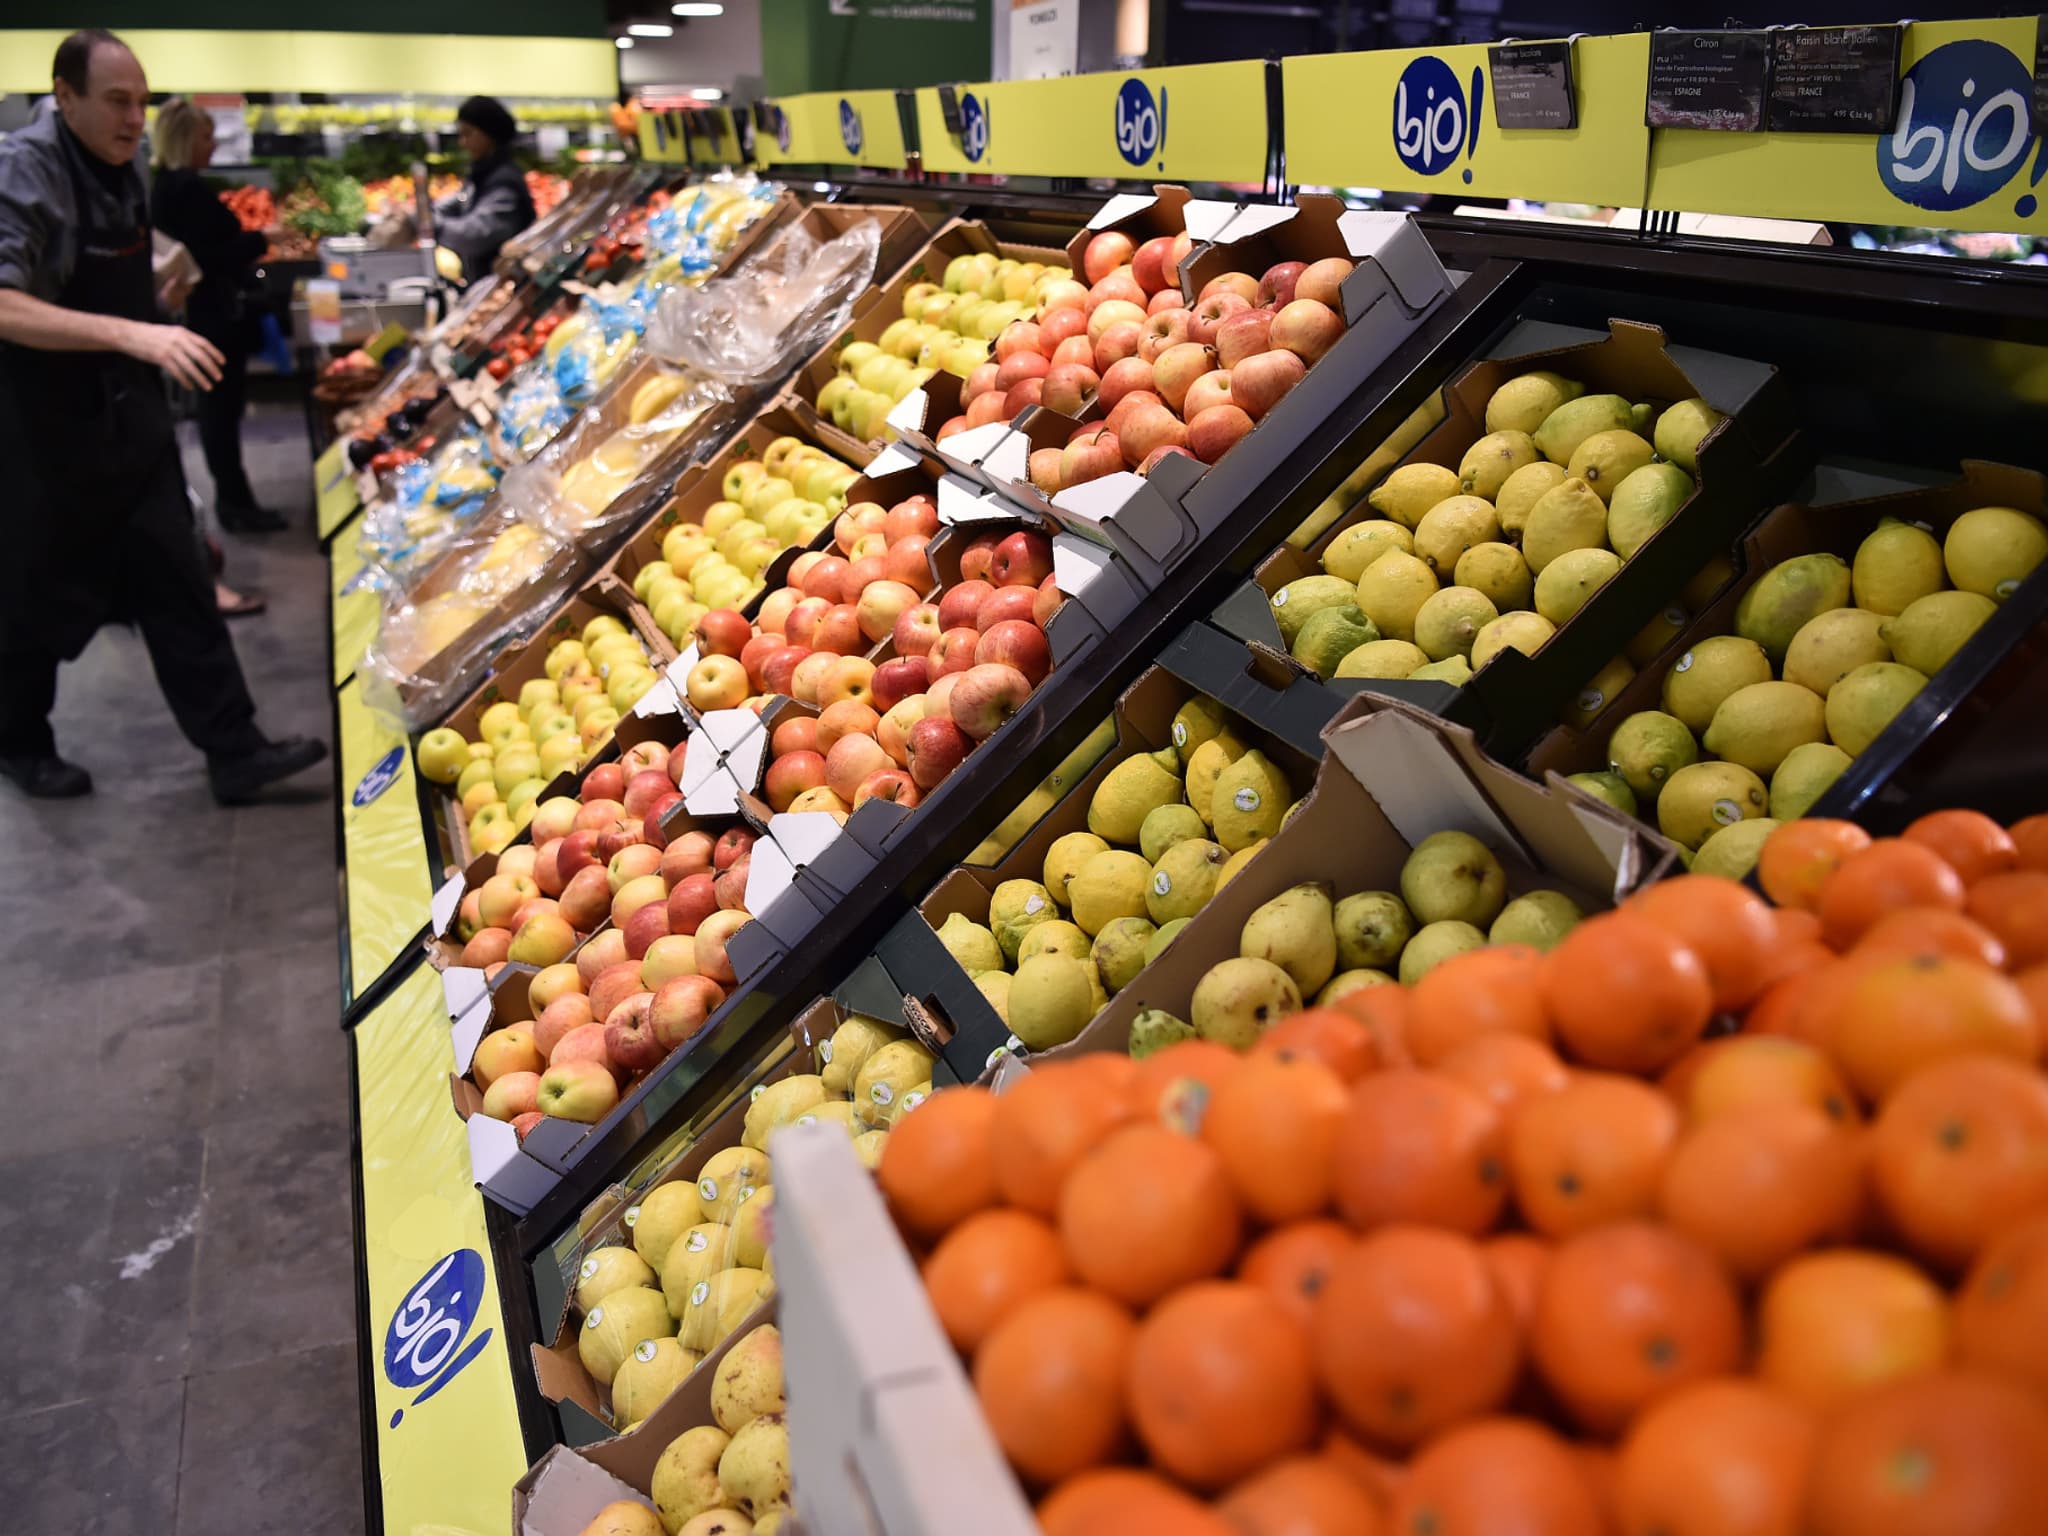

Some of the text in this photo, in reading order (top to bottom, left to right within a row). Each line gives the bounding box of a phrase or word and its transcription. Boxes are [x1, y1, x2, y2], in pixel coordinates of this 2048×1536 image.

[1694, 37, 1719, 48] Citron
[1796, 34, 1820, 45] Raisin
[1674, 87, 1703, 96] ESPAGNE
[1798, 87, 1823, 96] FRANCE
[1117, 86, 1168, 172] bio!
[1397, 65, 1485, 185] bio!
[390, 1254, 494, 1429] bio!
